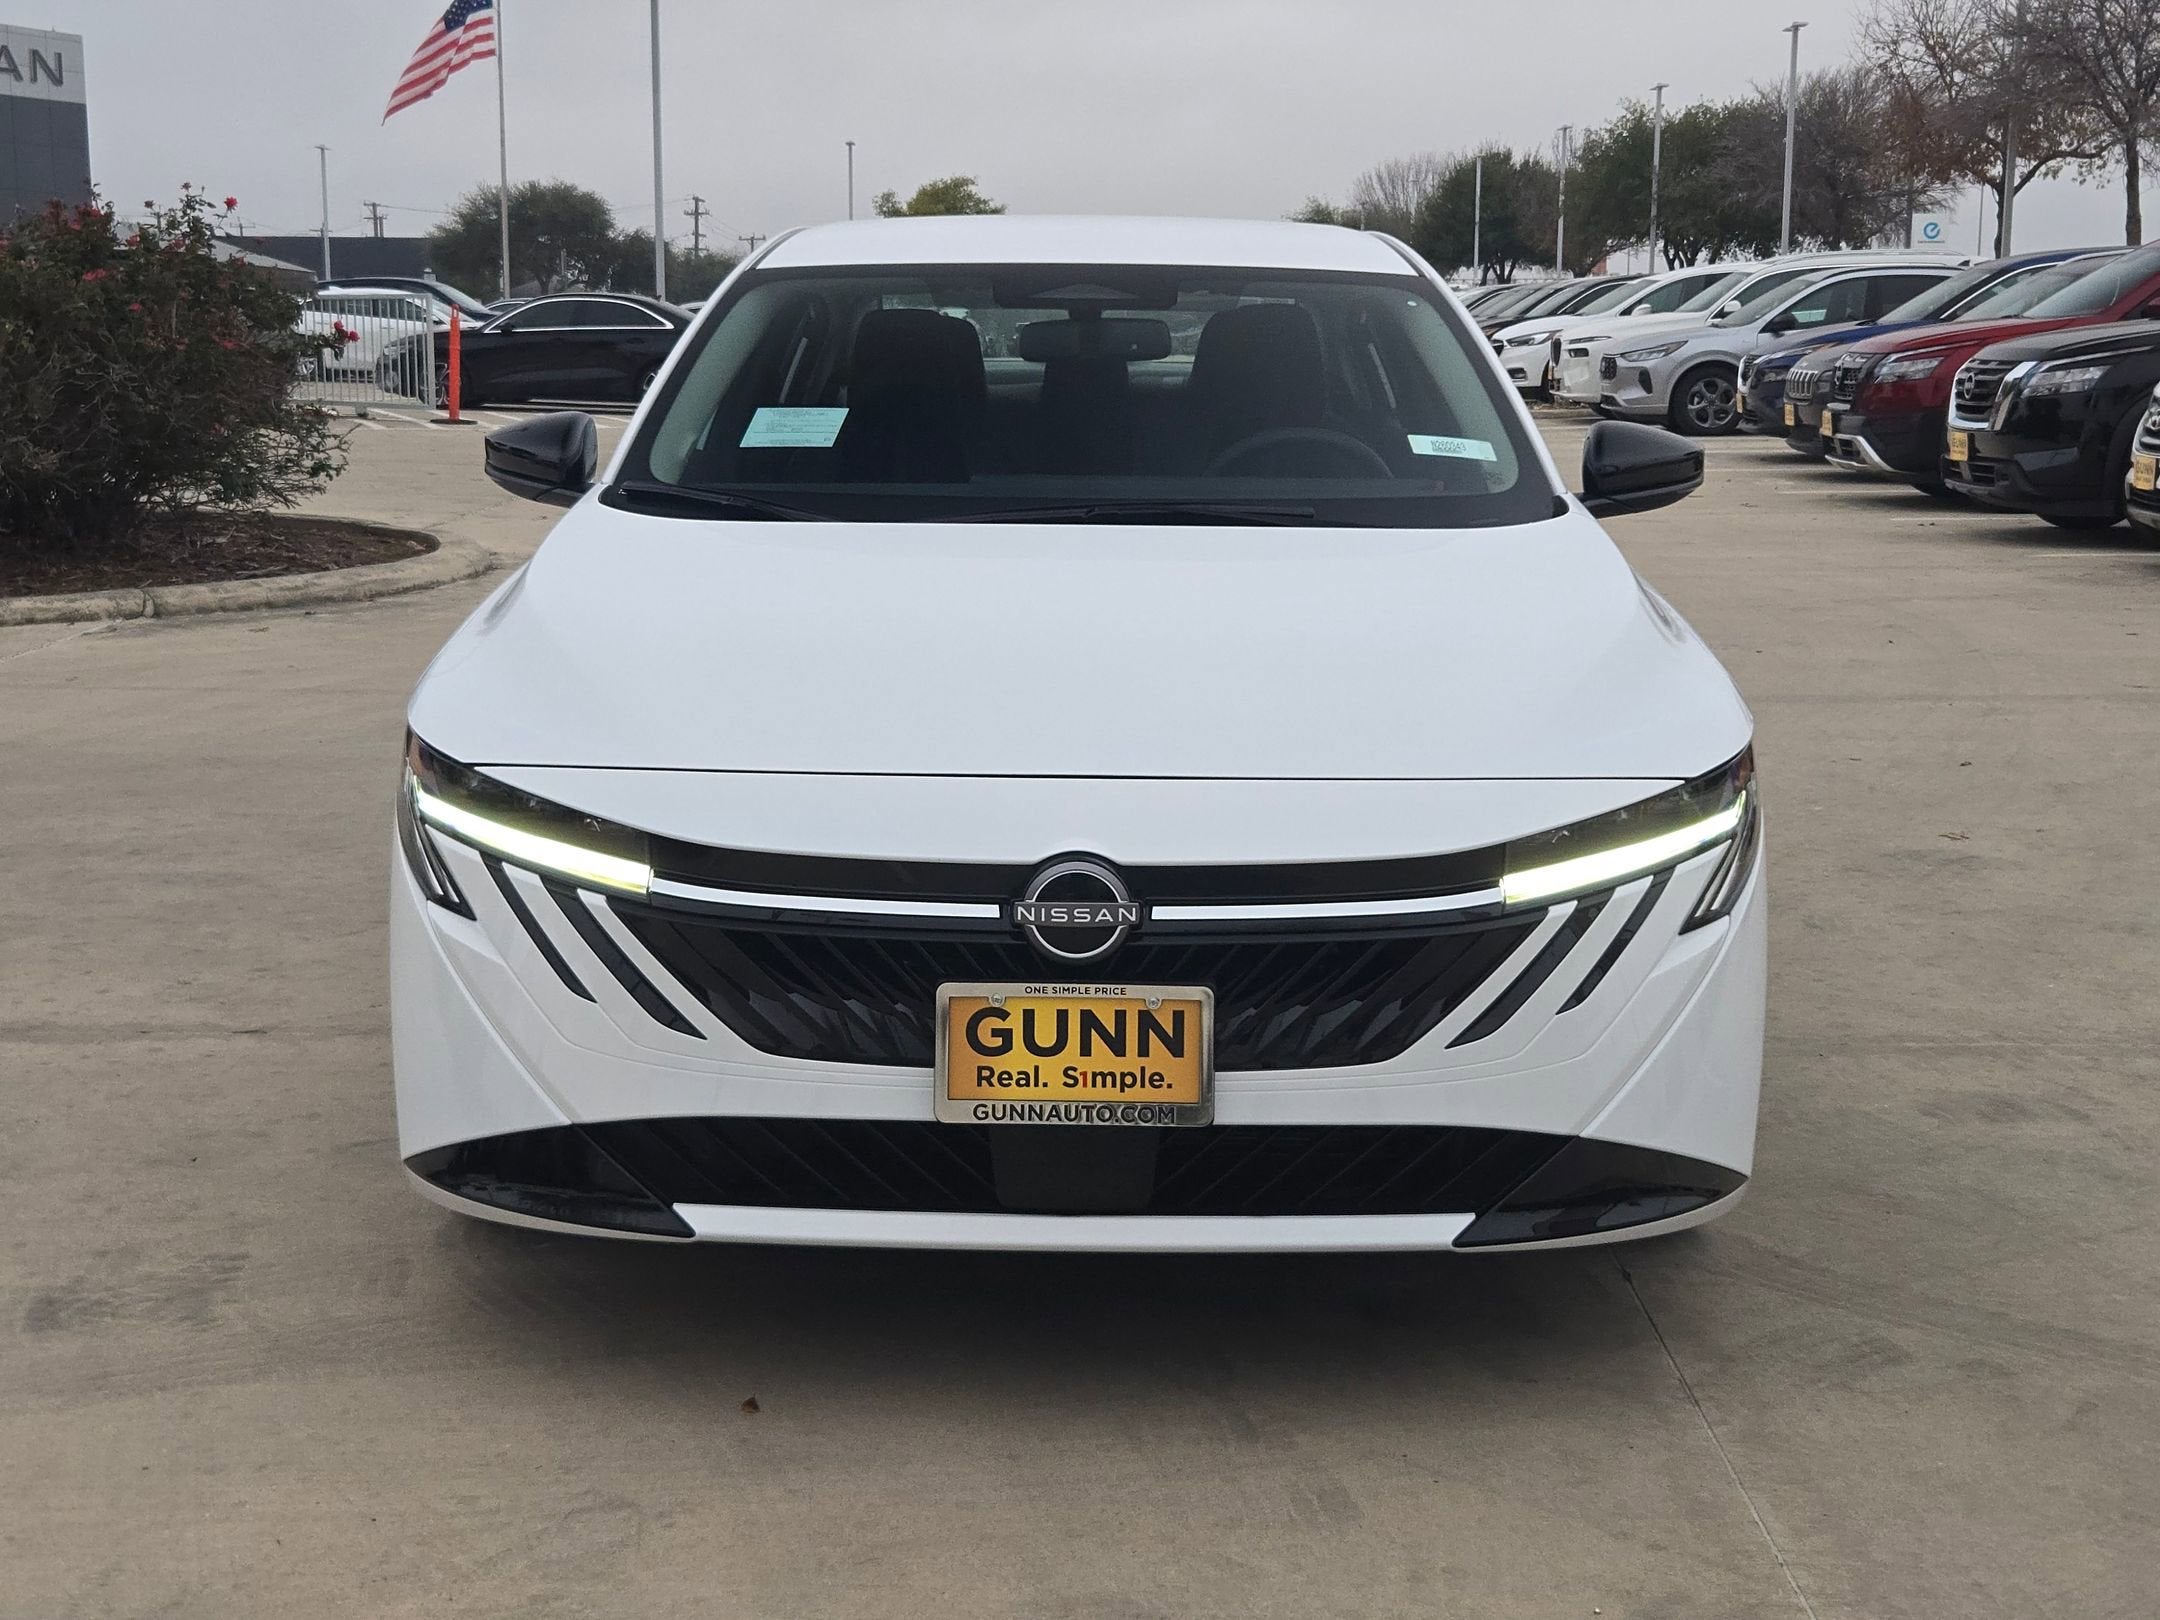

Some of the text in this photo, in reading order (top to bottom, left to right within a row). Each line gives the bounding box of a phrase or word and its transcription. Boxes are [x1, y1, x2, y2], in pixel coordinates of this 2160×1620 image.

[1017, 906, 1136, 922] NISSAN
[1024, 986, 1127, 995] ONE SIMPLE PRICE
[966, 1007, 1185, 1057] GUNN
[976, 1065, 1048, 1088] Real.
[972, 1103, 1176, 1124] GUNNAUTO.COM
